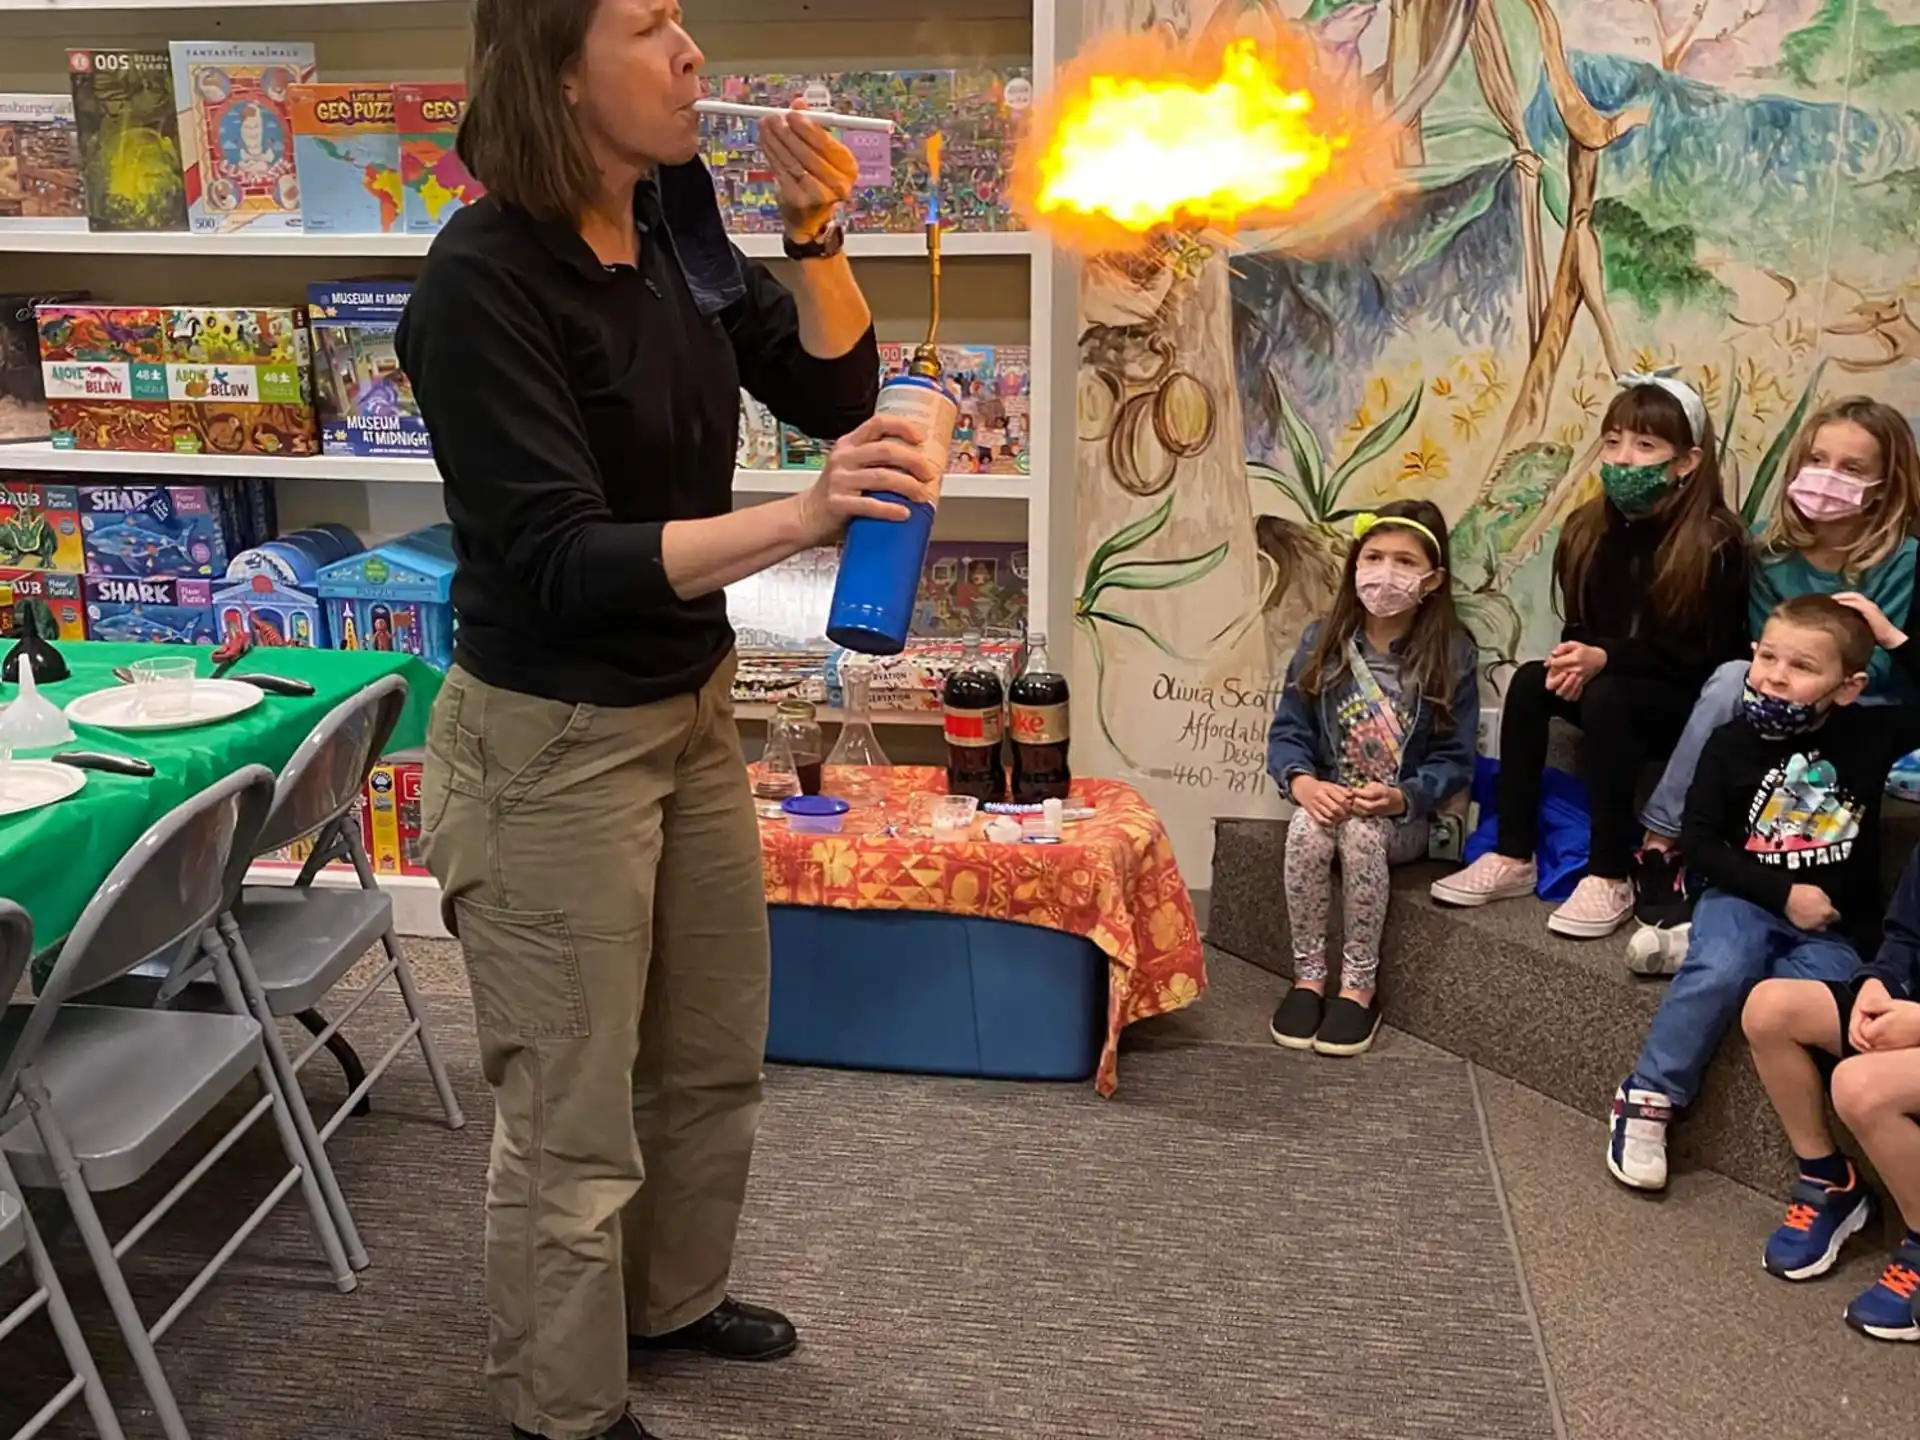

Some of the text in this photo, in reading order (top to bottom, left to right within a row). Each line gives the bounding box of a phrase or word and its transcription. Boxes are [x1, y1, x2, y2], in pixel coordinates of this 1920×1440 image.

[186, 45, 299, 57] FANTASTIC ANIMALS
[316, 101, 351, 120] GEO
[422, 102, 457, 119] GEO
[194, 218, 215, 230] 500
[331, 292, 373, 305] MUSEUM
[375, 294, 385, 303] AT
[52, 366, 84, 380] ABOVE
[136, 369, 150, 380] 48
[263, 372, 278, 383] 48
[85, 381, 122, 394] BELOW
[210, 383, 250, 397] BELOW
[346, 415, 400, 430] MUSEUM
[363, 431, 374, 443] AT
[48, 500, 72, 508] Puzzle
[91, 490, 150, 513] SHAR
[177, 501, 201, 510] Puzzle
[50, 587, 73, 597] Puzzle
[98, 582, 171, 605] SHARK
[181, 586, 201, 594] Floor
[182, 594, 206, 604] Puzzle
[1153, 673, 1284, 713] Olivia Scott
[1757, 841, 1853, 870] THE STARS
